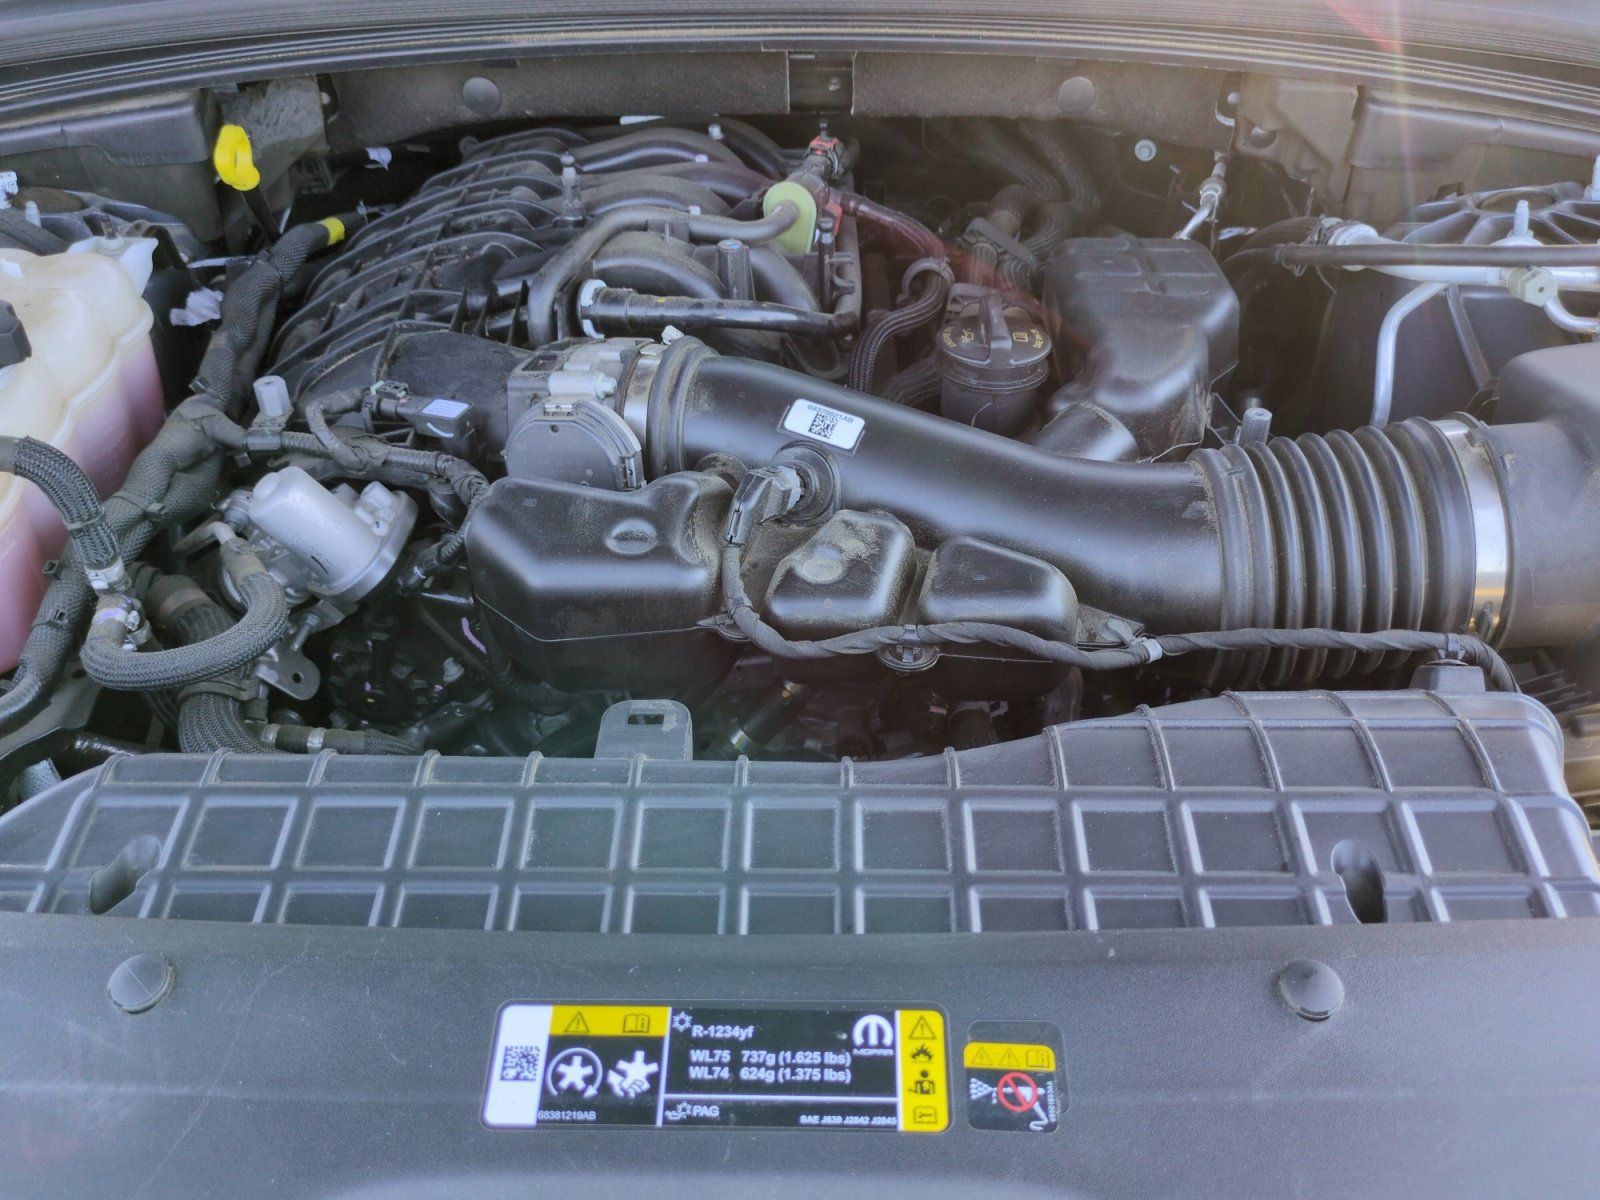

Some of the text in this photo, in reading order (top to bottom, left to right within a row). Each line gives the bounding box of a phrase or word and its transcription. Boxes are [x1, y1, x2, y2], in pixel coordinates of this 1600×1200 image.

[691, 1024, 755, 1040] R-1234yf
[690, 1049, 852, 1067] WL75 737g (1.625 lbs)
[688, 1066, 852, 1084] WL74 624g (1.375 lbs)
[692, 1105, 720, 1117] PAG
[800, 1114, 820, 1125] SAE
